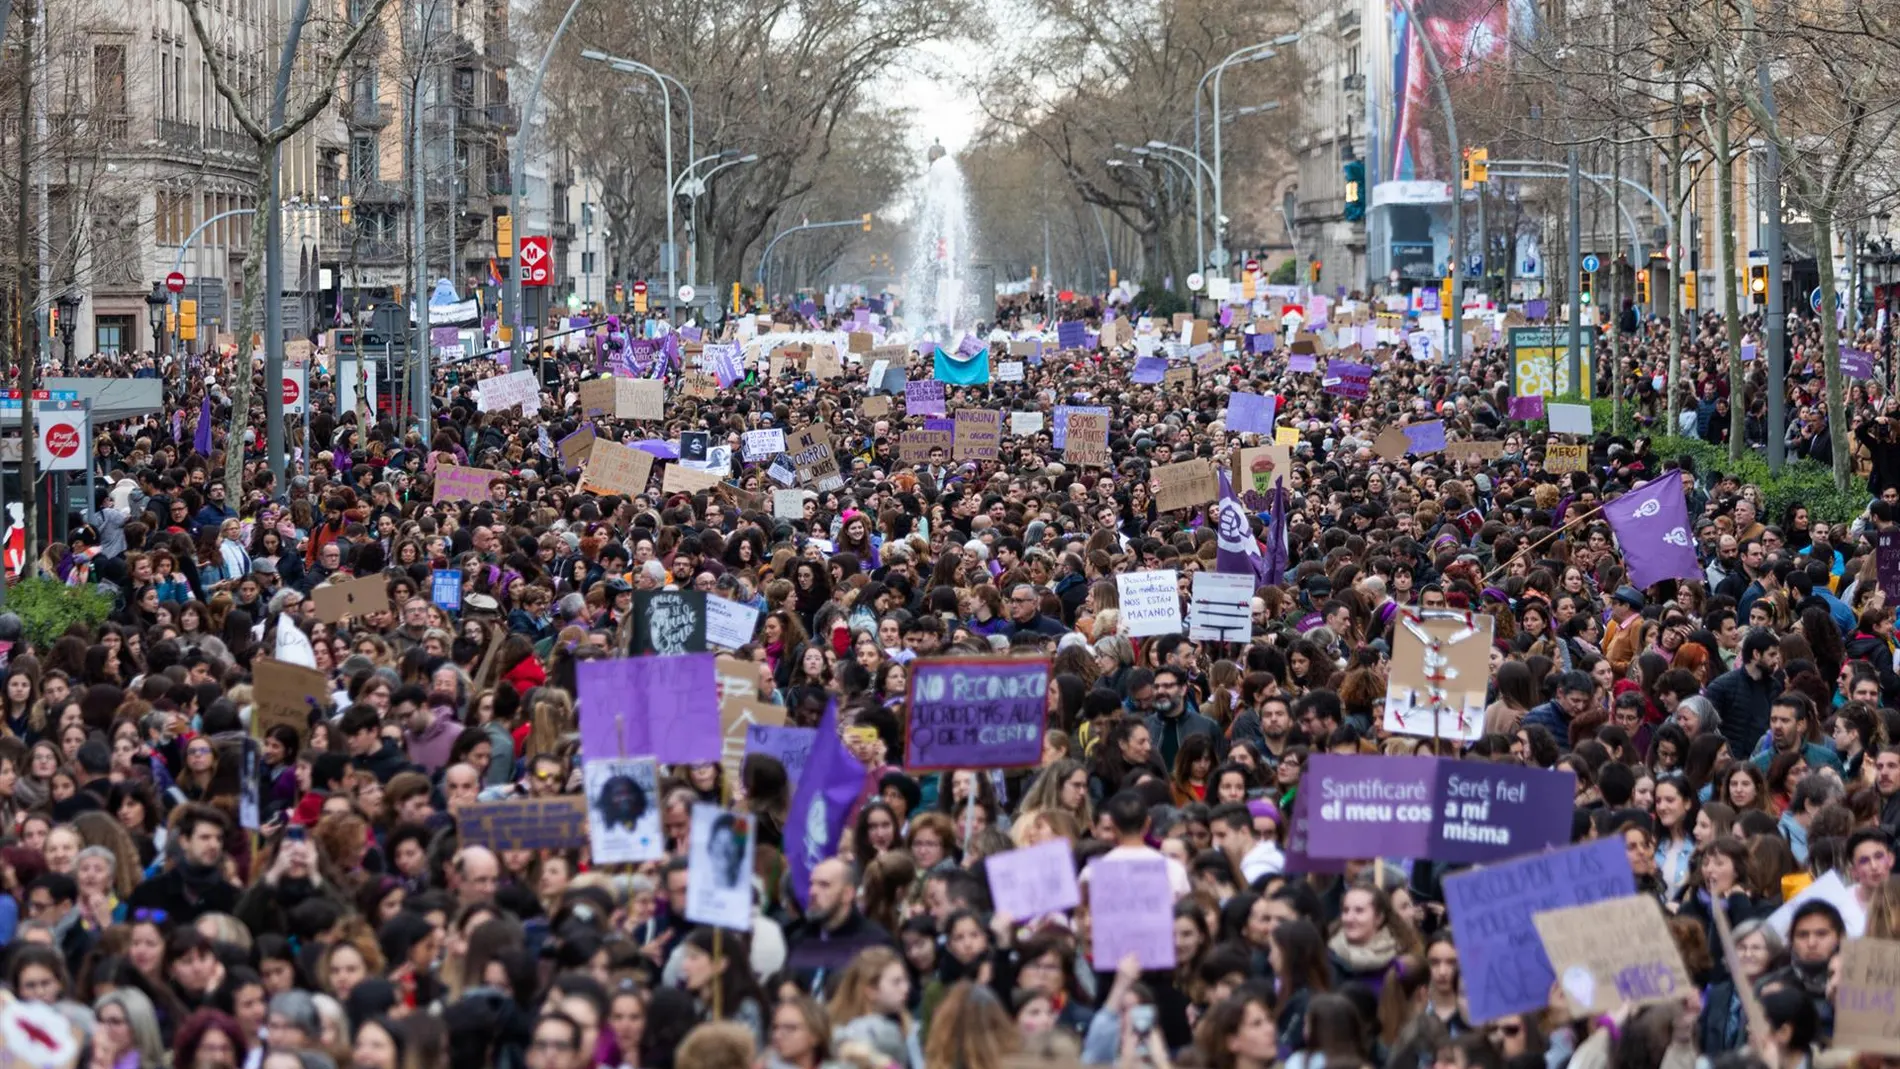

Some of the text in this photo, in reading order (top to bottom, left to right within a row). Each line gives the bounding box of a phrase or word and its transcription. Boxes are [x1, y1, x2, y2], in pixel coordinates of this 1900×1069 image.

[527, 248, 538, 259] M
[49, 440, 78, 448] Parada
[795, 443, 829, 465] CUERPO
[1123, 574, 1165, 584] Disculpen
[1125, 584, 1175, 596] las molestias
[1124, 599, 1140, 607] NOS
[1128, 607, 1175, 620] MATANDO
[916, 672, 1048, 702] NO RECONOZCO
[938, 729, 959, 745] DE
[978, 724, 1038, 744] CUERPO
[1447, 775, 1528, 804] Seré fiel
[1320, 803, 1433, 823] el meu cos
[1444, 804, 1458, 818] a
[1442, 822, 1511, 846] misma
